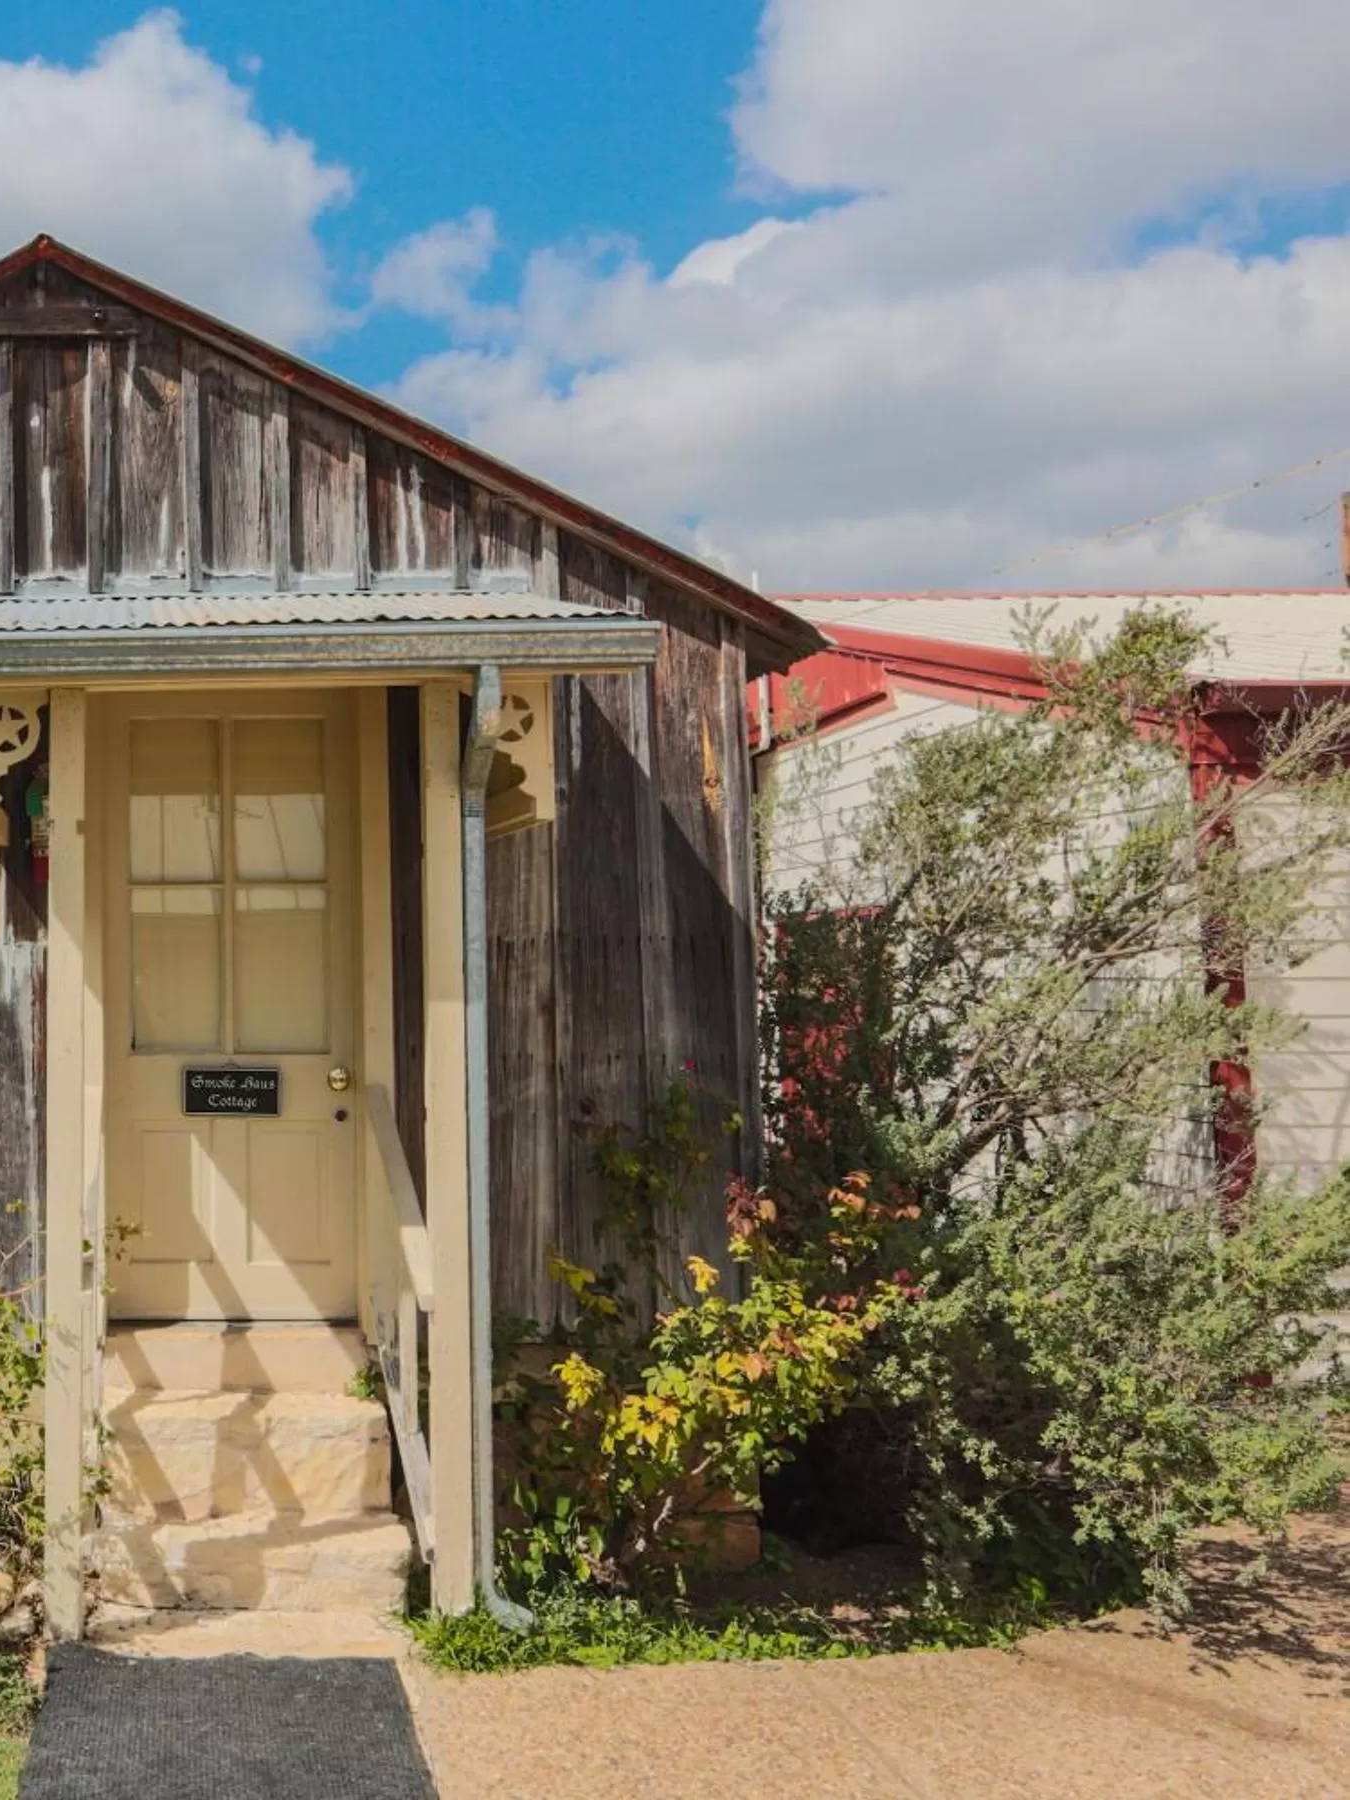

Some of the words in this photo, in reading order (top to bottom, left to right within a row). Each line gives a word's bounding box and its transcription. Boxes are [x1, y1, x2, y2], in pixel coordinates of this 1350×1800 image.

[191, 1075, 236, 1088] Smoke
[240, 1075, 276, 1090] Haus
[208, 1093, 257, 1111] Cottage
